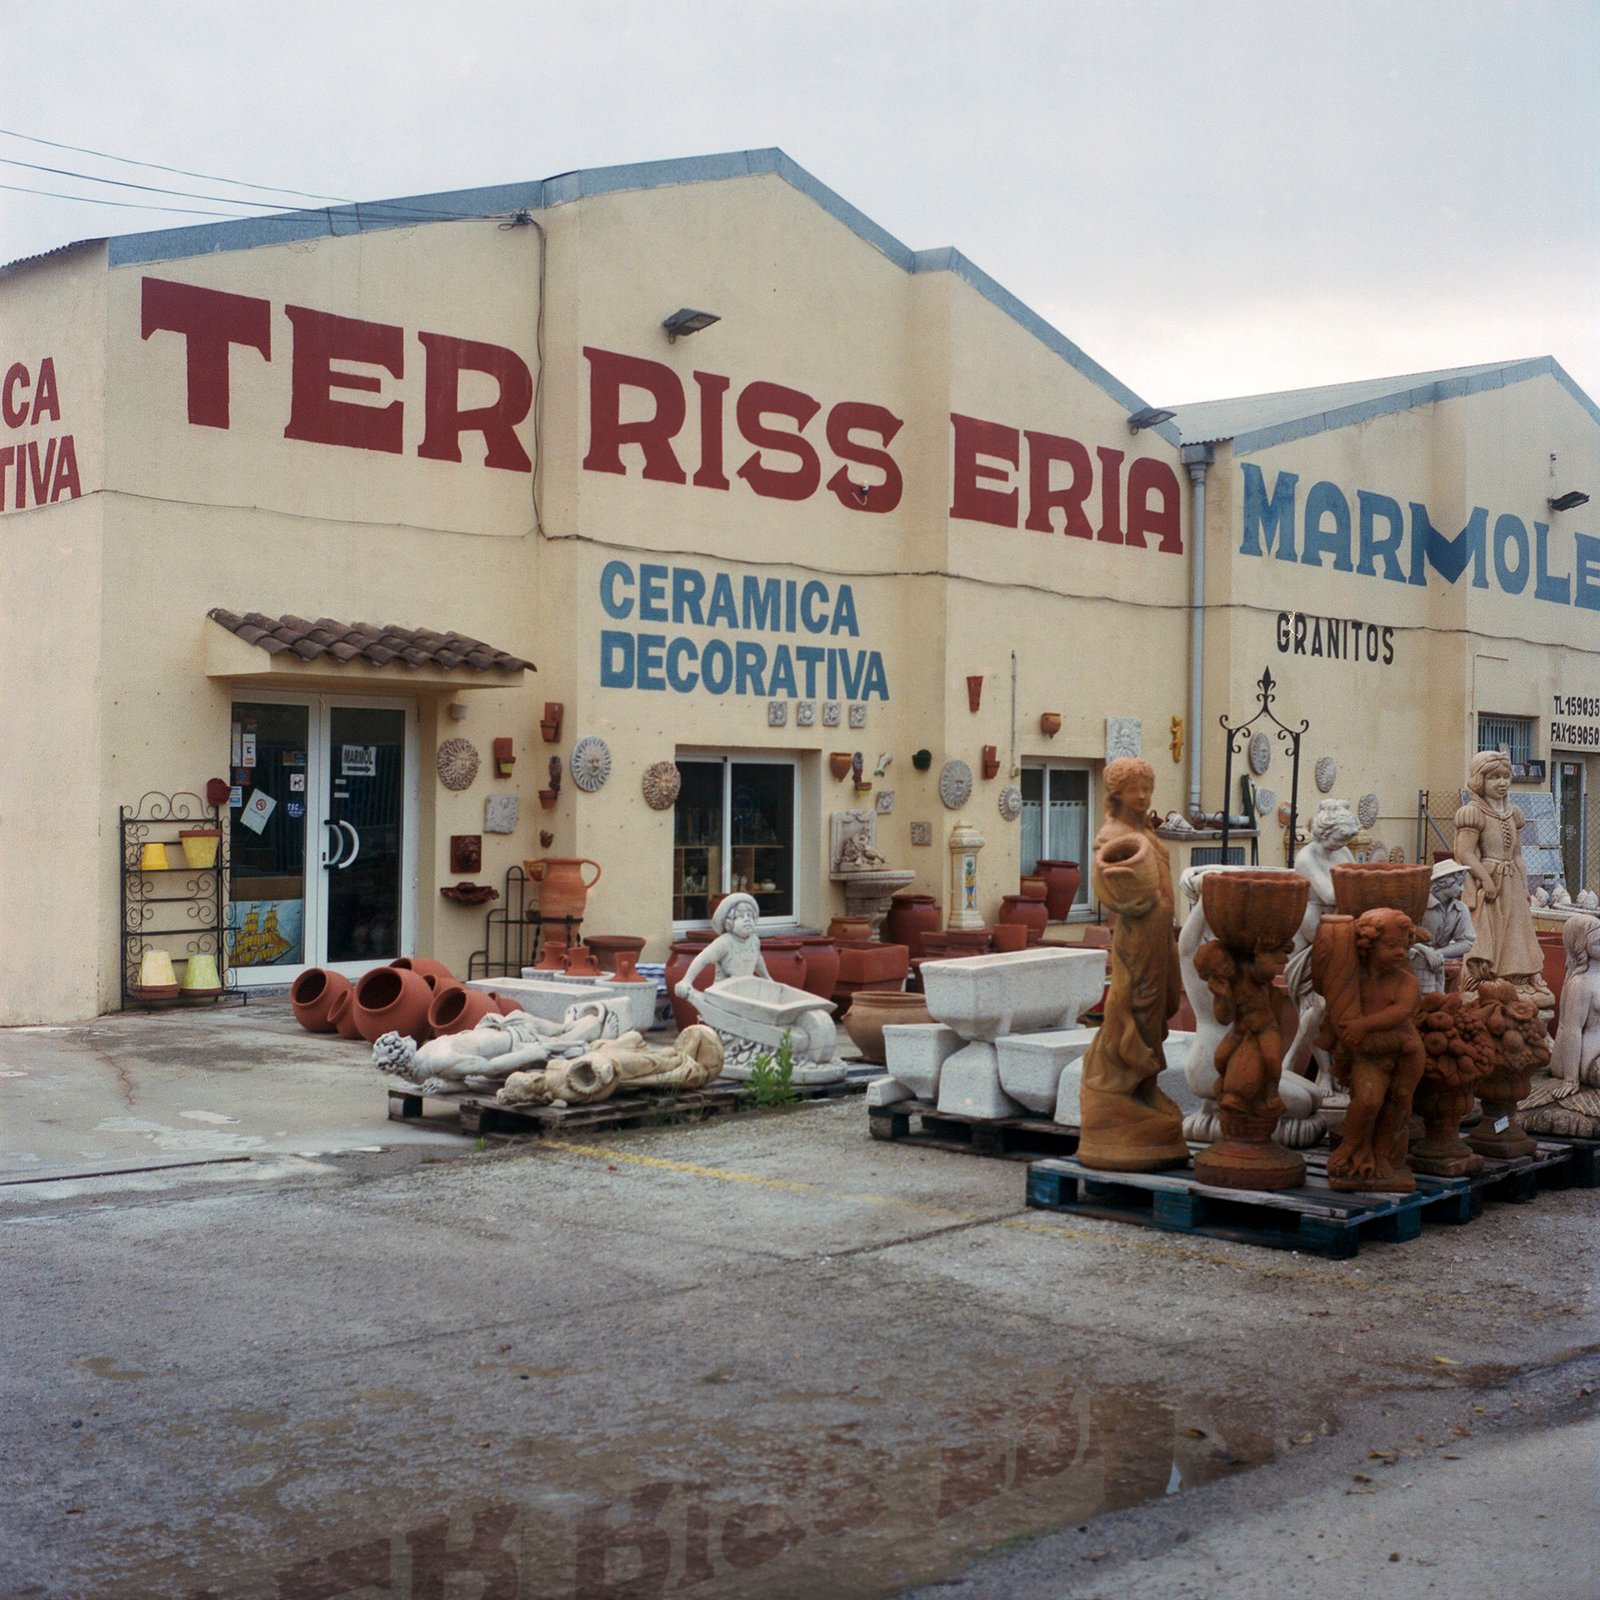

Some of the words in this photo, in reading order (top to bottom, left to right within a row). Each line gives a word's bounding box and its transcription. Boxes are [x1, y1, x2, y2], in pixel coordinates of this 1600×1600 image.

[600, 560, 859, 637] CERAMICA
[600, 630, 889, 701] DECORATIVA
[1276, 612, 1394, 665] GRANITOS
